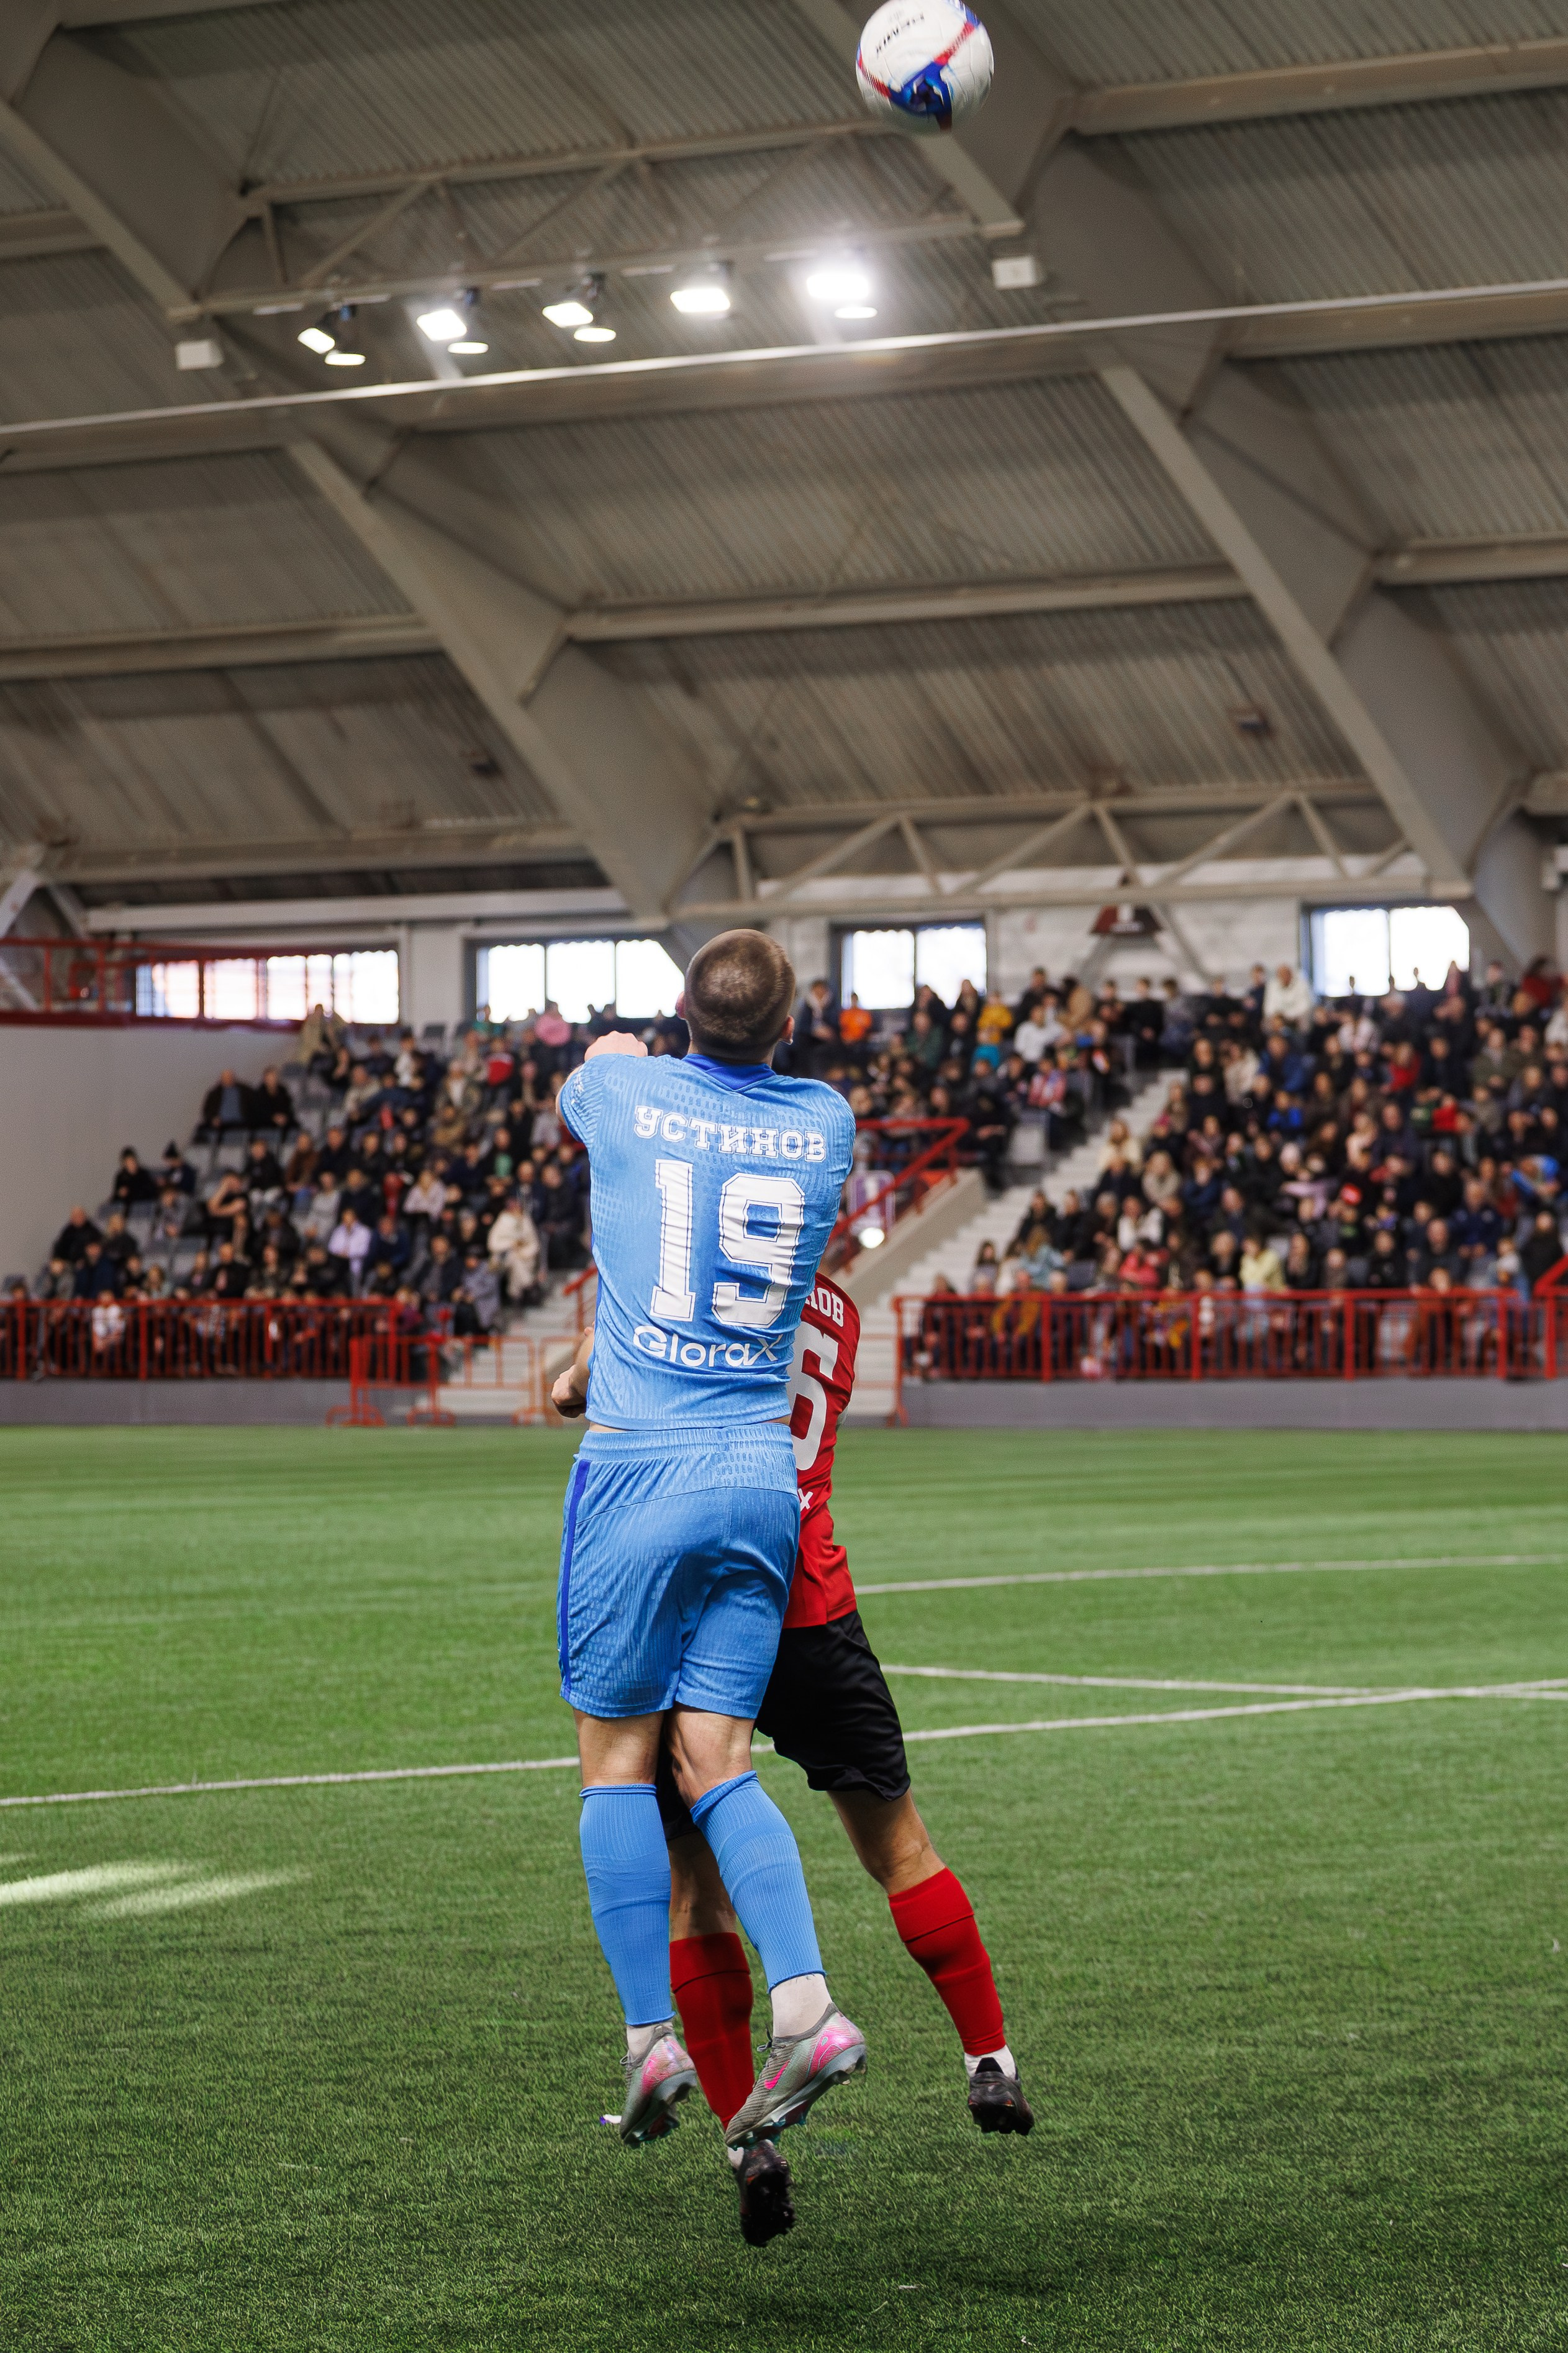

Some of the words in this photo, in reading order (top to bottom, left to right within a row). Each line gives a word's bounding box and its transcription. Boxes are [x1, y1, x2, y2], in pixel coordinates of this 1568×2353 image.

[634, 1105, 826, 1163] УСТИНОВ
[650, 1158, 805, 1329] 19
[633, 1325, 784, 1368] GloraX
[787, 1321, 839, 1471] 6
